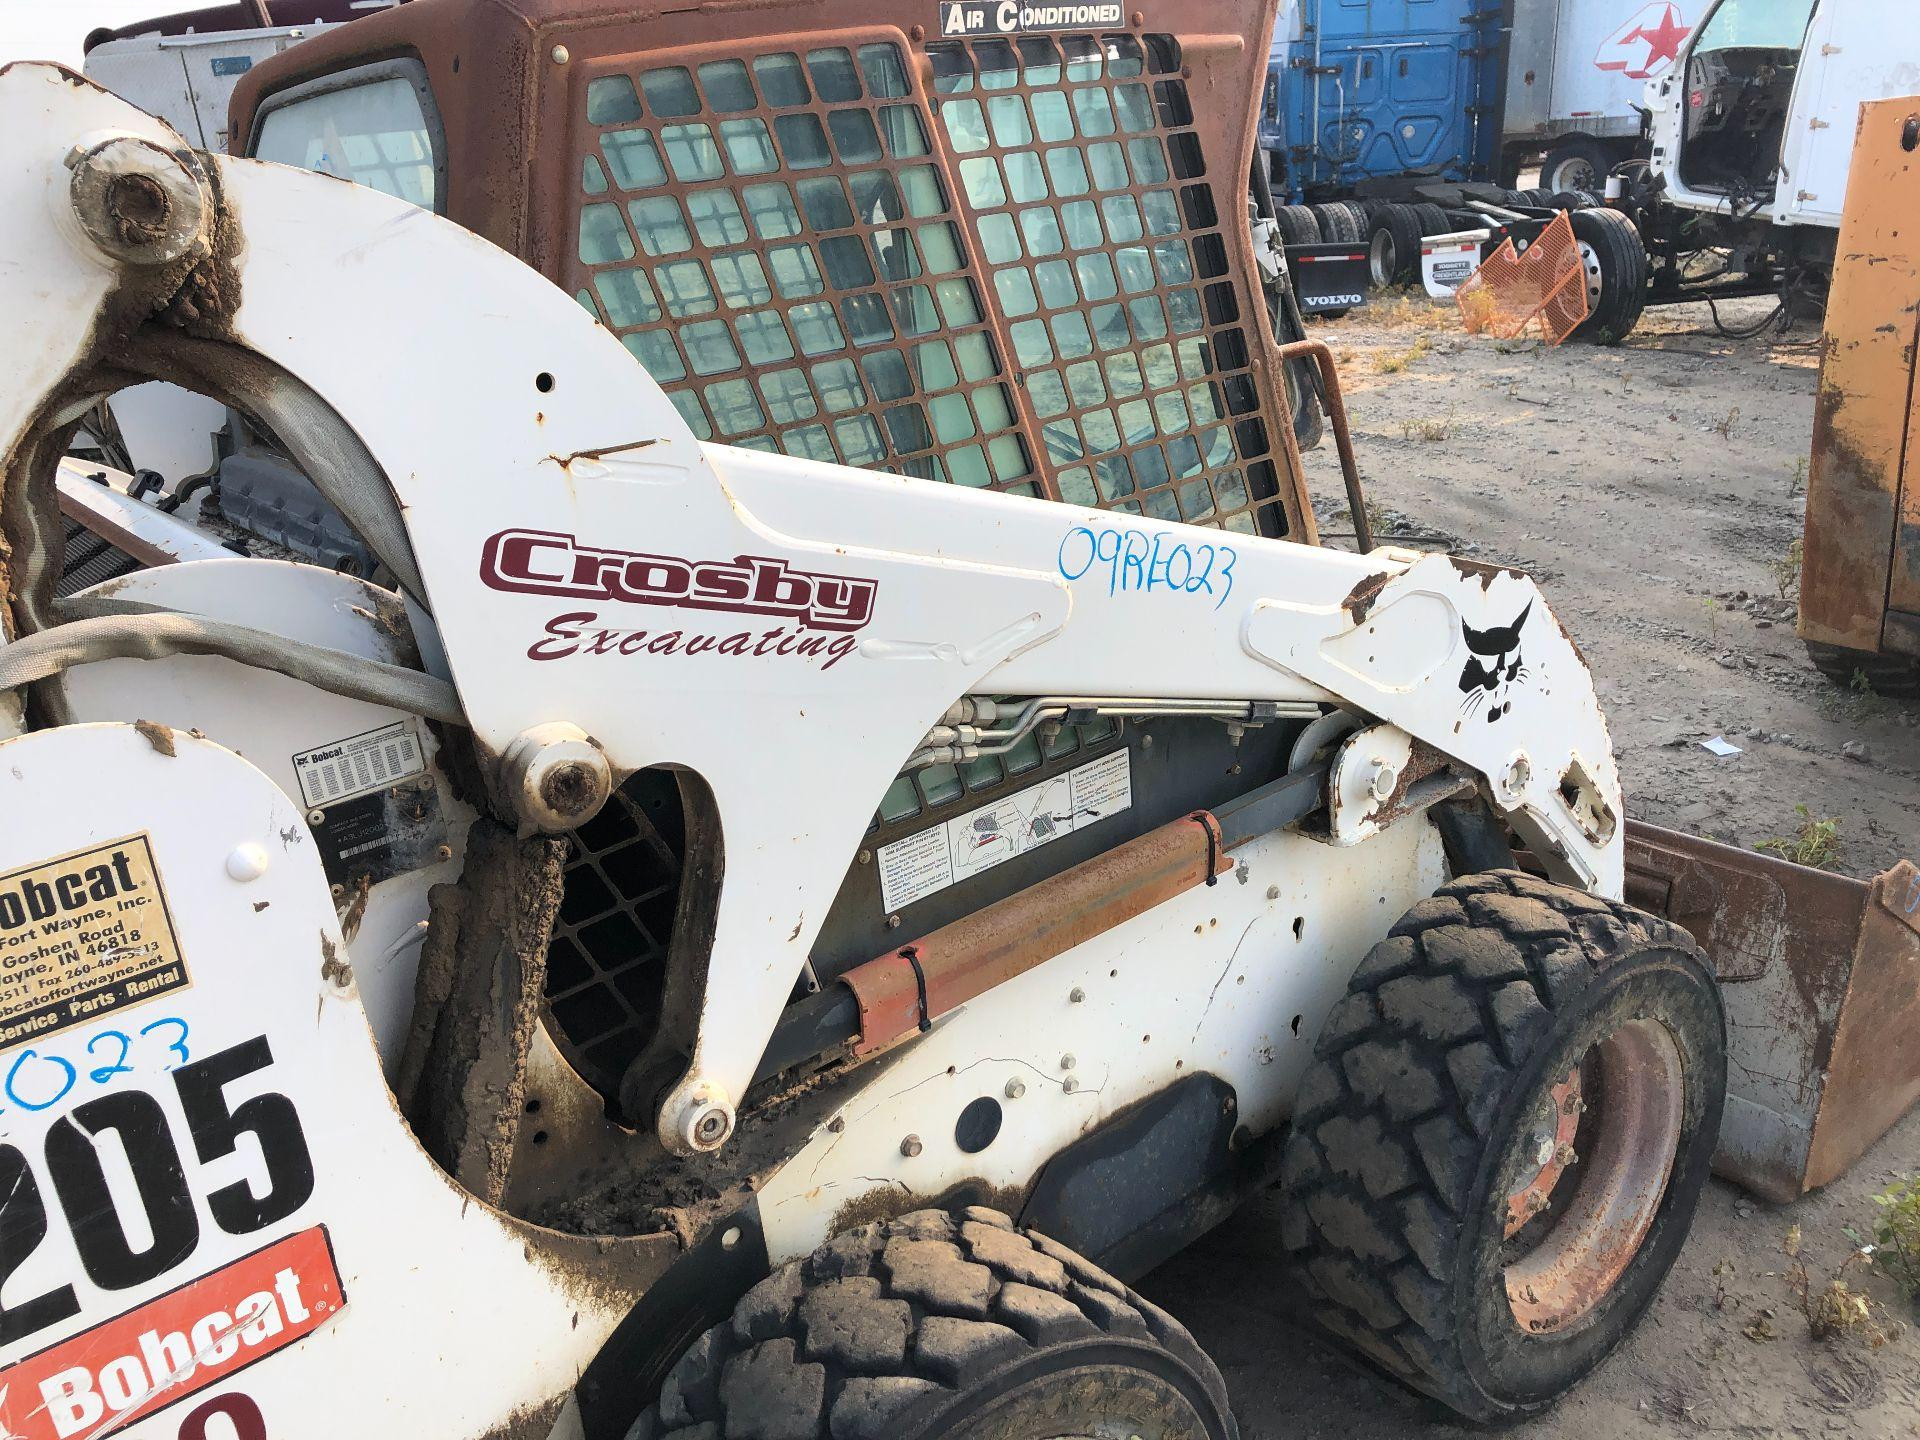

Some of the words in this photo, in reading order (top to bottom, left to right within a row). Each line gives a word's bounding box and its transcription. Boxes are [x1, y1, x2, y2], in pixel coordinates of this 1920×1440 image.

[944, 3, 985, 34] AIR
[996, 1, 1120, 32] CONDITIONED
[1303, 293, 1362, 306] VOLVO
[479, 528, 879, 632] Crosby
[1058, 526, 1237, 611] 09RE023
[527, 611, 859, 671] Excavating
[311, 746, 344, 764] Bobcat
[0, 851, 138, 930] obcat
[41, 908, 113, 935] Wayne,
[117, 895, 152, 912] Inc.
[0, 964, 53, 987] ayne,
[58, 950, 80, 966] IN
[86, 929, 142, 956] 46818
[2, 939, 74, 969] Goshen
[78, 919, 125, 945] Road
[38, 975, 62, 989] Fax
[68, 990, 116, 1018] Parts
[125, 967, 181, 997] Rental
[0, 1017, 190, 1115] 023
[38, 1265, 311, 1440] Bobcat
